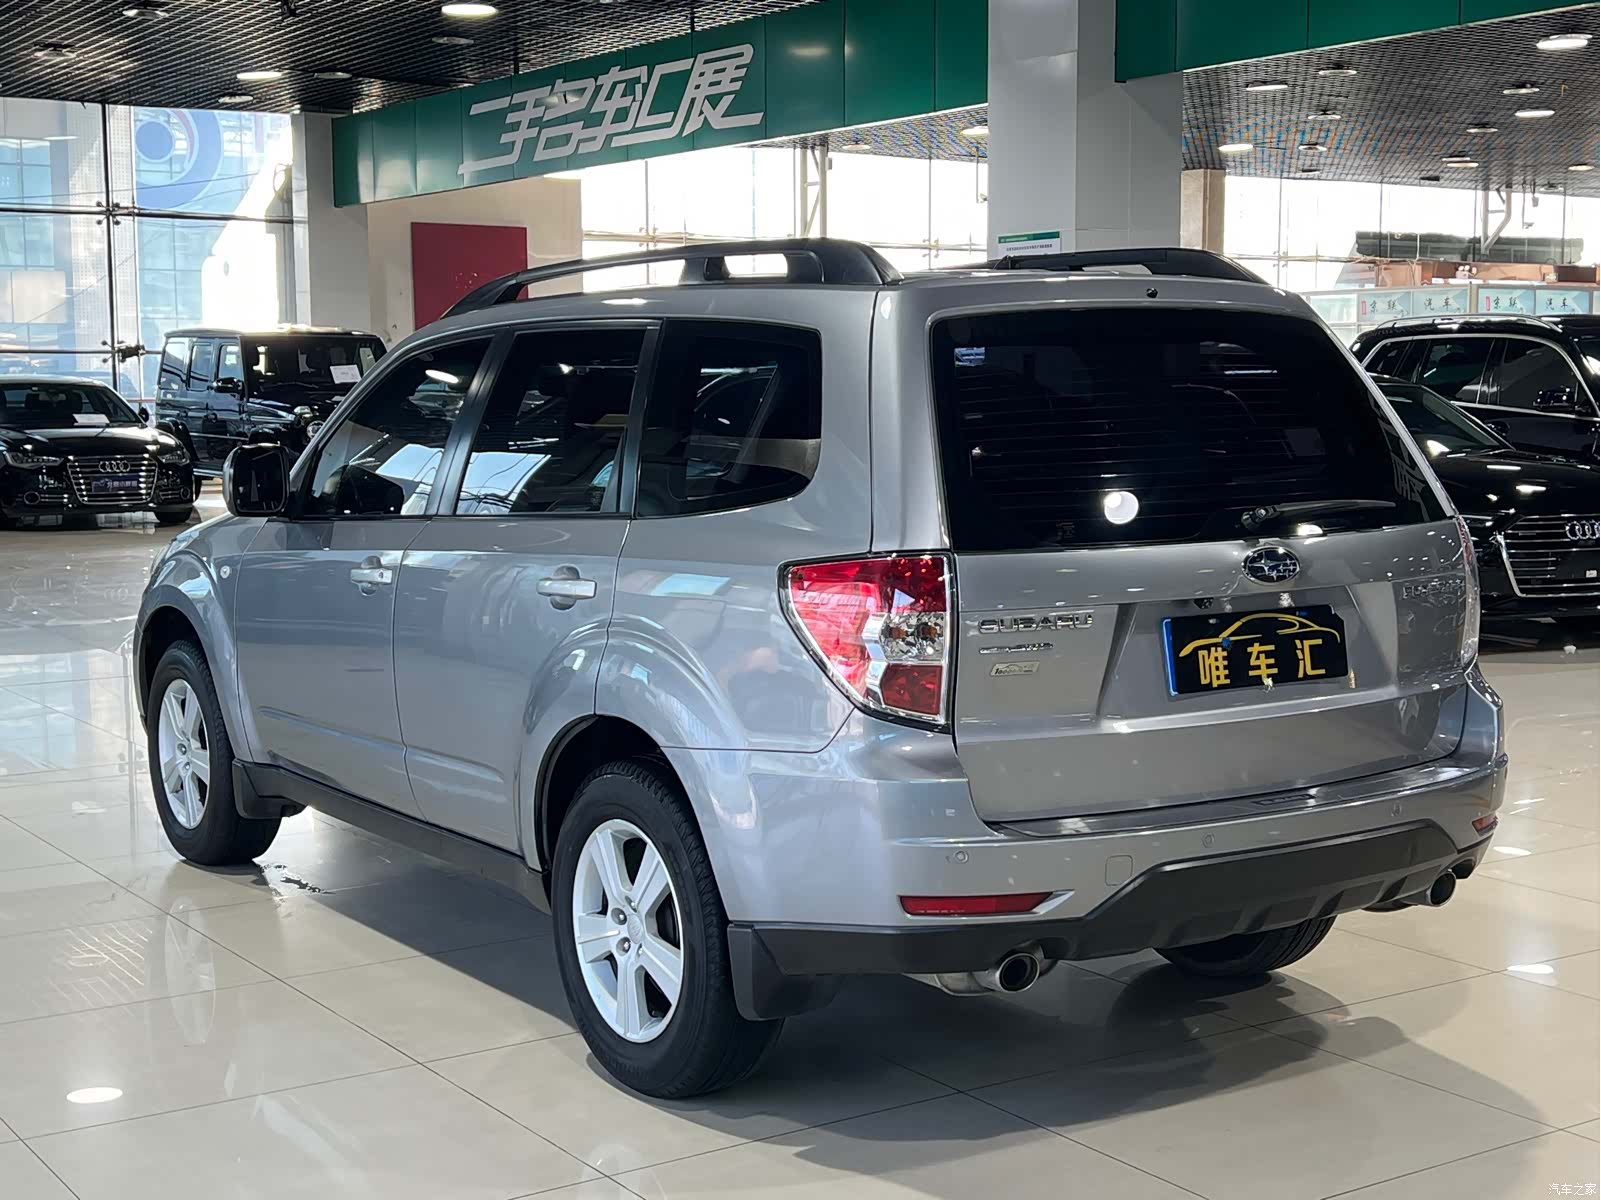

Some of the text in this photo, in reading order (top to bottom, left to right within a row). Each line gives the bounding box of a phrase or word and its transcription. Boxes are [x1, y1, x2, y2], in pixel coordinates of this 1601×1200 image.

[457, 44, 764, 175] 二手名车汇展
[979, 613, 1095, 634] SUBARU
[1198, 639, 1327, 688] 唯车汇
